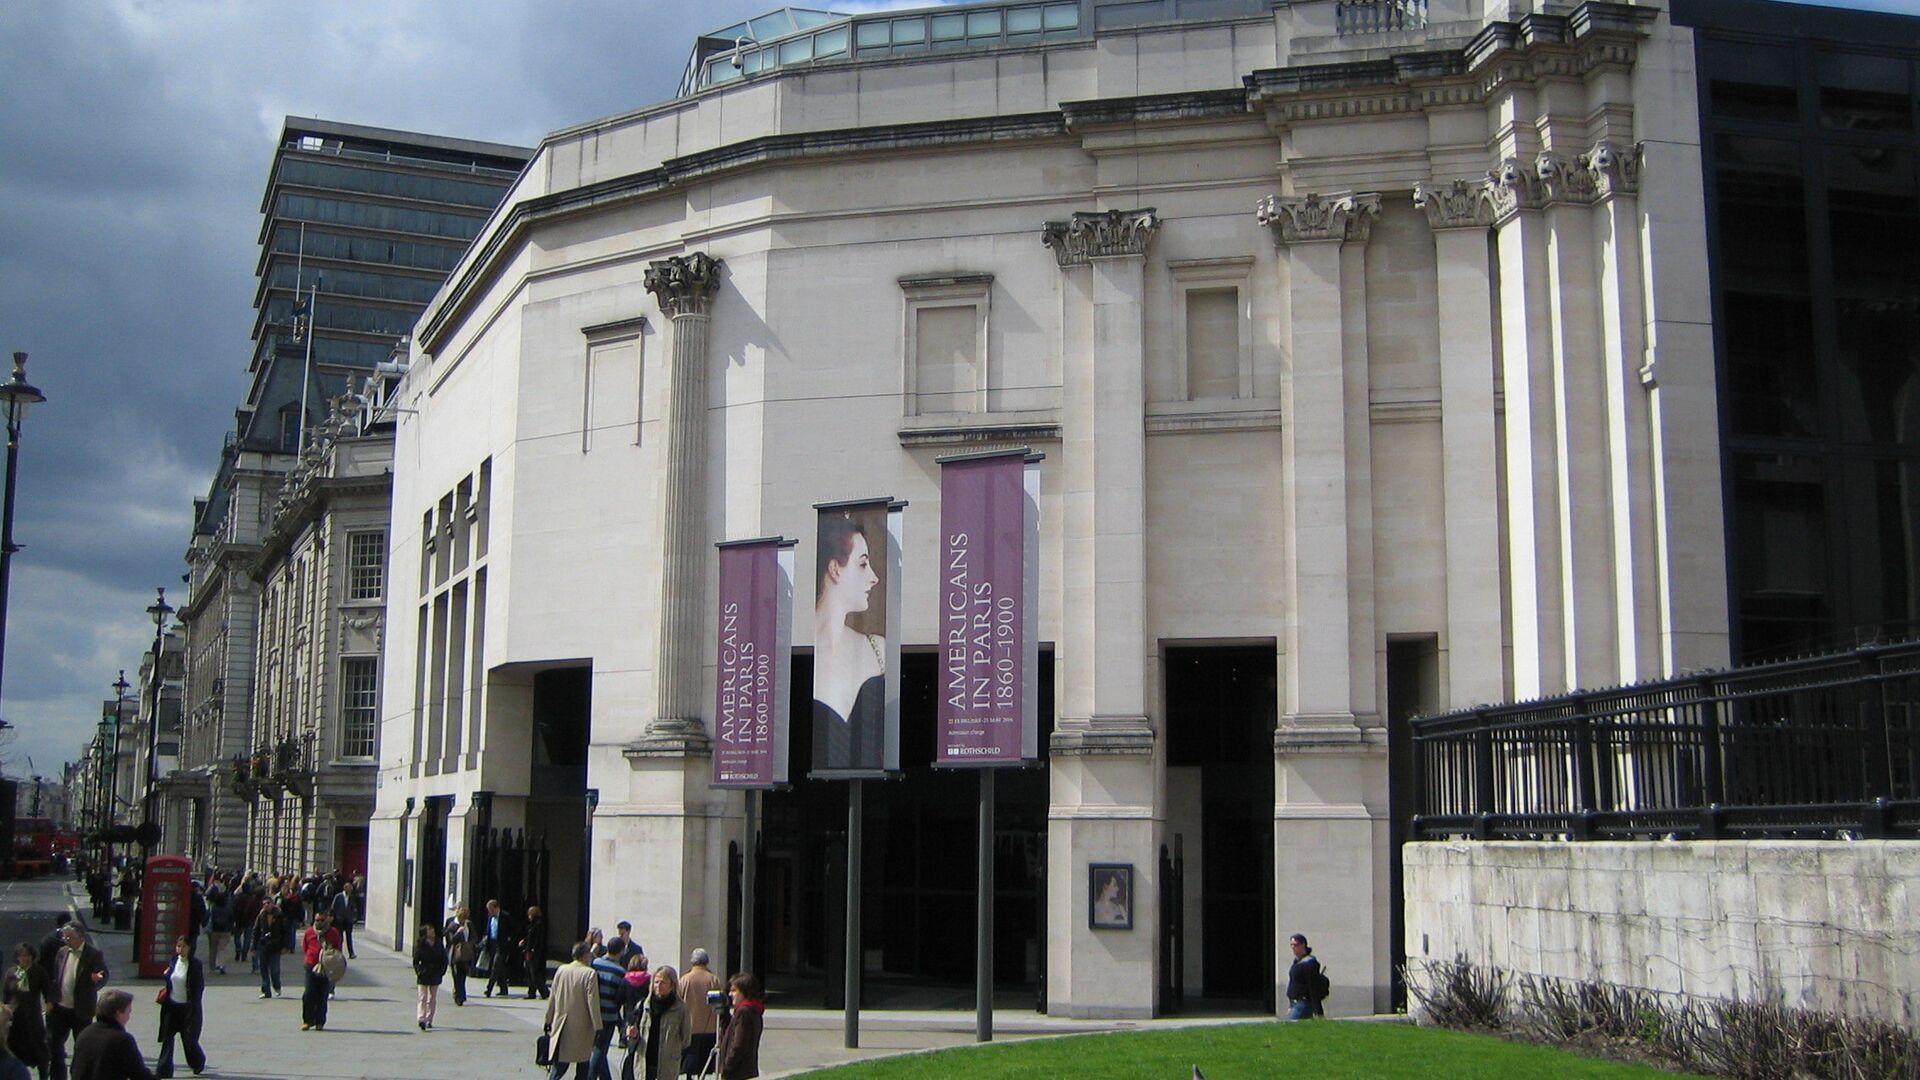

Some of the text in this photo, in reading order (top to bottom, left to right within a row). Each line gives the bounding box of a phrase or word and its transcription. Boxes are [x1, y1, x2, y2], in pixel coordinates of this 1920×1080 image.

[721, 603, 738, 743] AMERICANS
[947, 533, 968, 710] AMERICANS
[972, 582, 992, 709] IN PARIS
[739, 642, 754, 743] IN PARIS
[960, 747, 1001, 755] ROTHSCHILD
